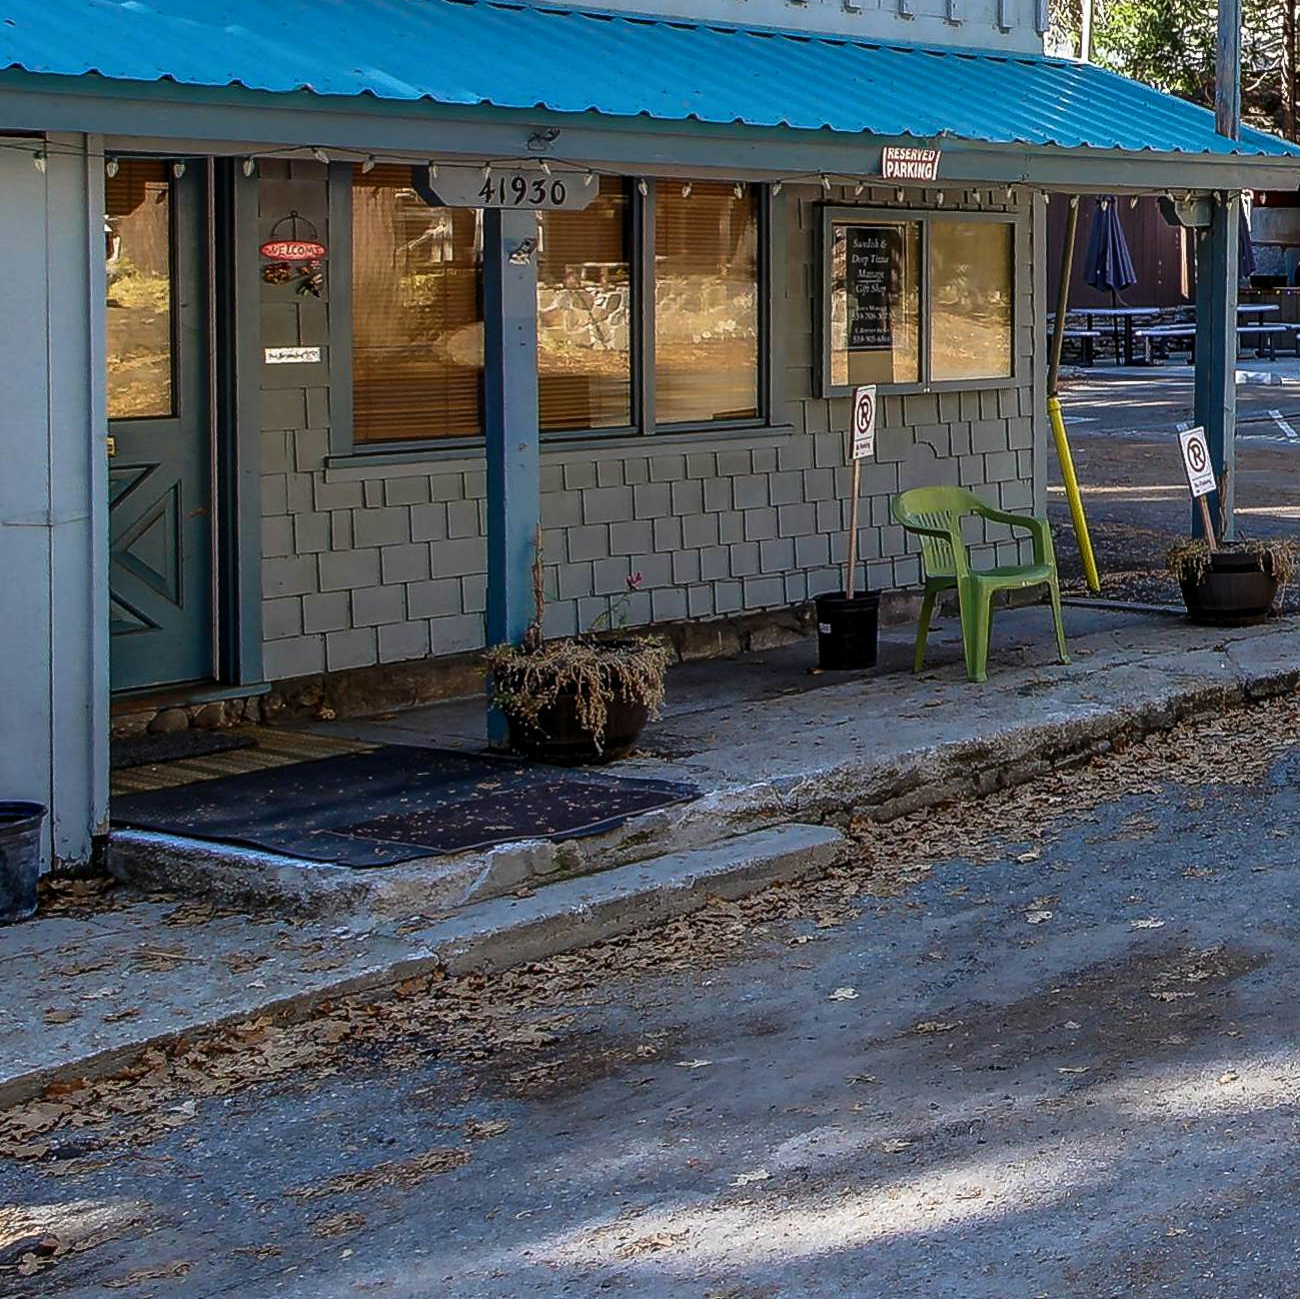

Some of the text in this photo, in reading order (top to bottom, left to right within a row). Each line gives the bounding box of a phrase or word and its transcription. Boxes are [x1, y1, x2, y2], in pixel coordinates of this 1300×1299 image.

[887, 147, 936, 161] RESERVED
[886, 160, 933, 179] PARKING
[478, 176, 566, 206] 41930
[266, 245, 322, 256] WELCOME
